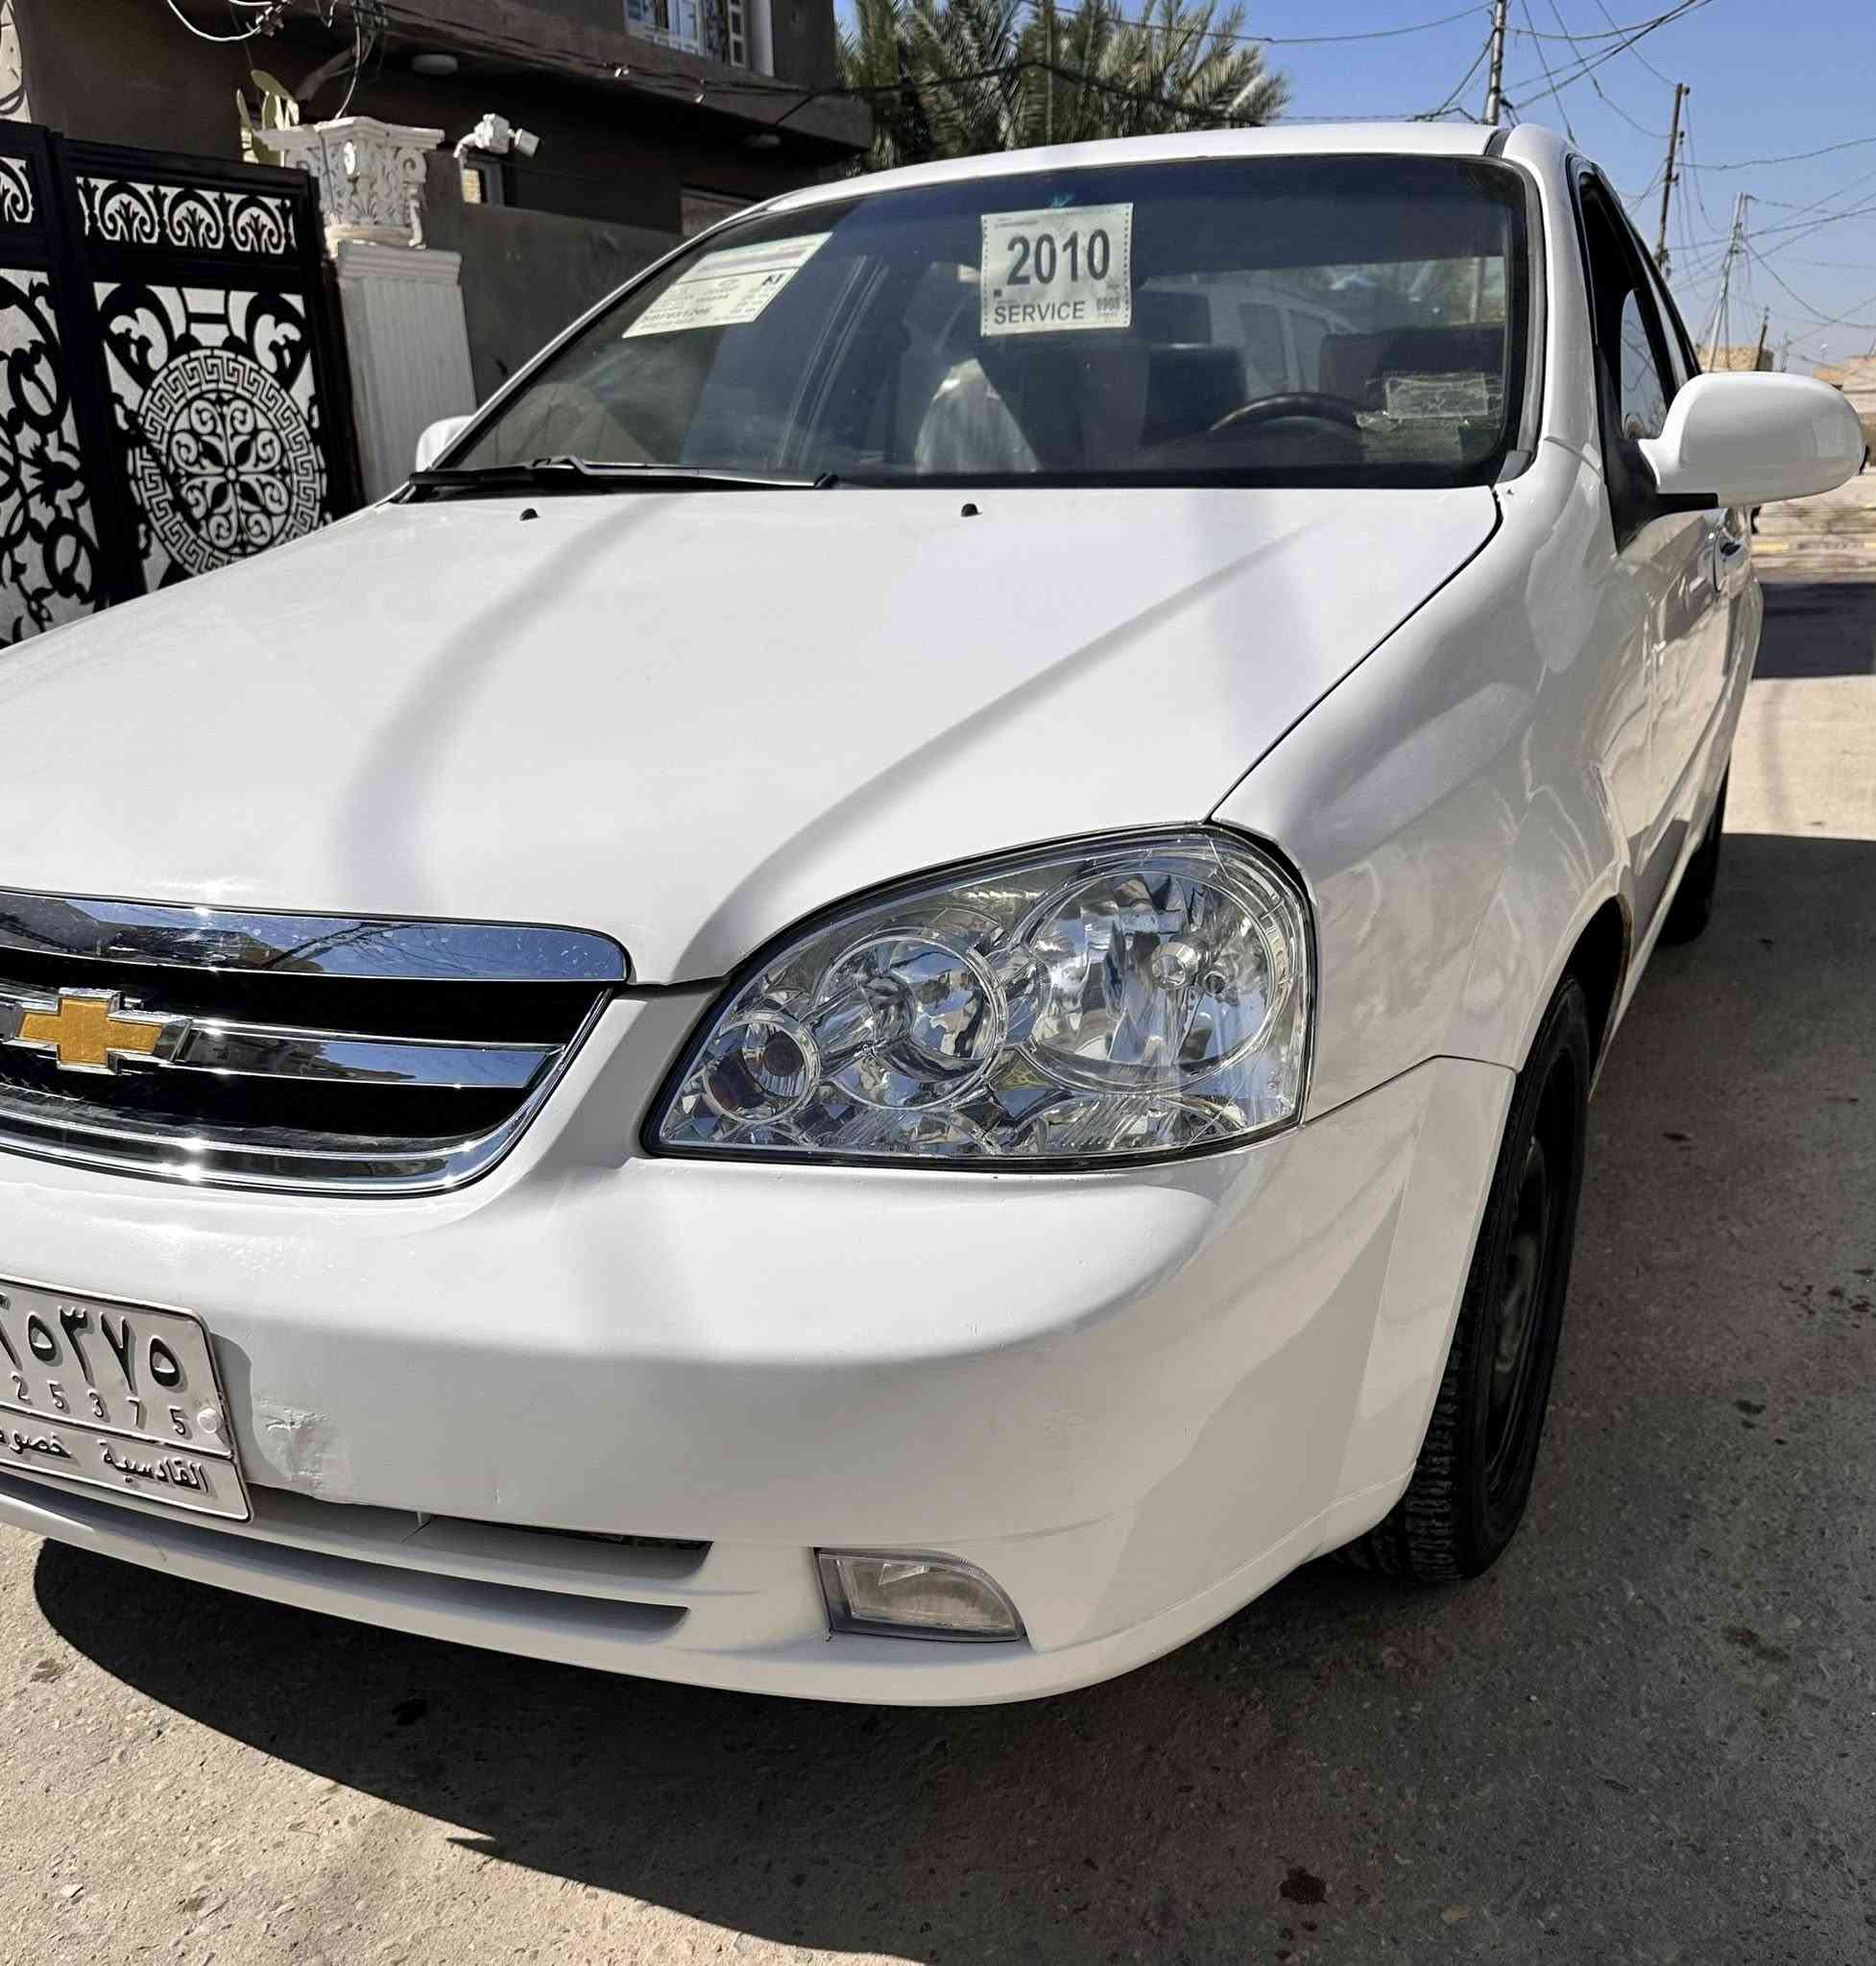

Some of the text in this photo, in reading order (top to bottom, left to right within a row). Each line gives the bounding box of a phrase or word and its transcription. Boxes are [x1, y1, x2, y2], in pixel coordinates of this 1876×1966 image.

[1007, 229, 1110, 285] 2010
[994, 300, 1086, 324] SERVICE
[98, 1439, 208, 1494] القادسية
